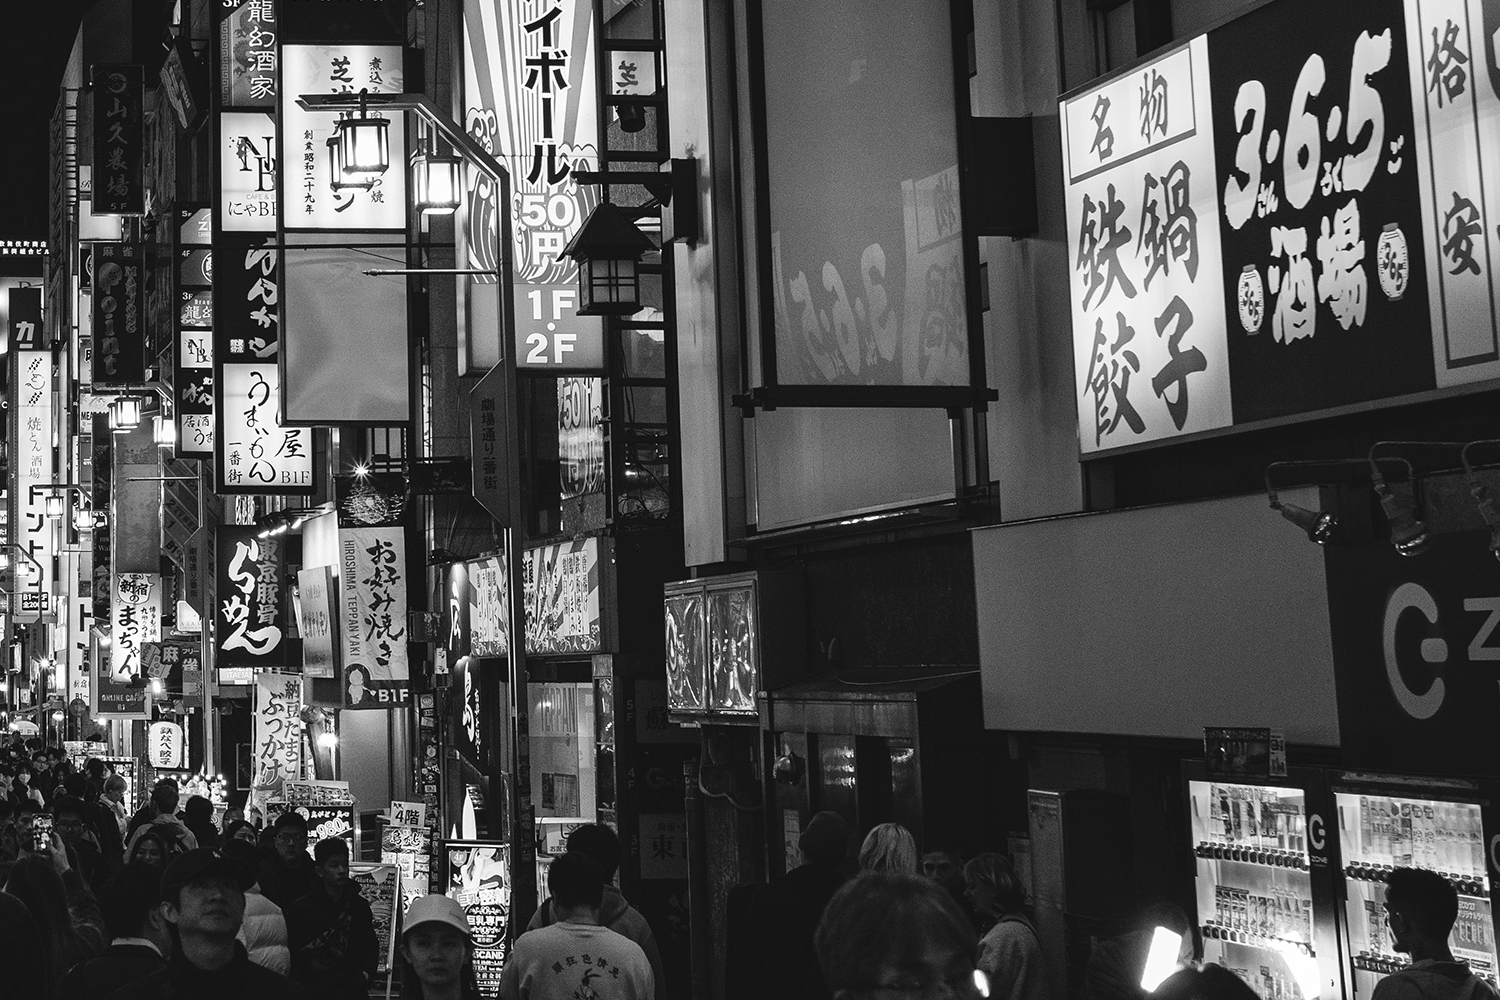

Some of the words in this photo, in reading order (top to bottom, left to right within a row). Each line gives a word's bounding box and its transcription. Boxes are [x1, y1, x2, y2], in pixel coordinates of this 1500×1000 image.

[1090, 68, 1168, 163] 名物
[304, 130, 316, 215] 創業昭和二十九年
[521, 193, 575, 227] 50
[1076, 160, 1201, 312] 鉄鍋
[1268, 198, 1368, 345] 酒場
[527, 290, 576, 320] 1F
[526, 333, 577, 363] 2F
[1083, 295, 1208, 448] 餃子
[281, 470, 310, 484] B1F
[343, 539, 357, 591] HIROSHIMA
[348, 595, 361, 656] TEPPANYAKI
[362, 539, 404, 667] お好み焼き
[378, 688, 409, 702] B1F
